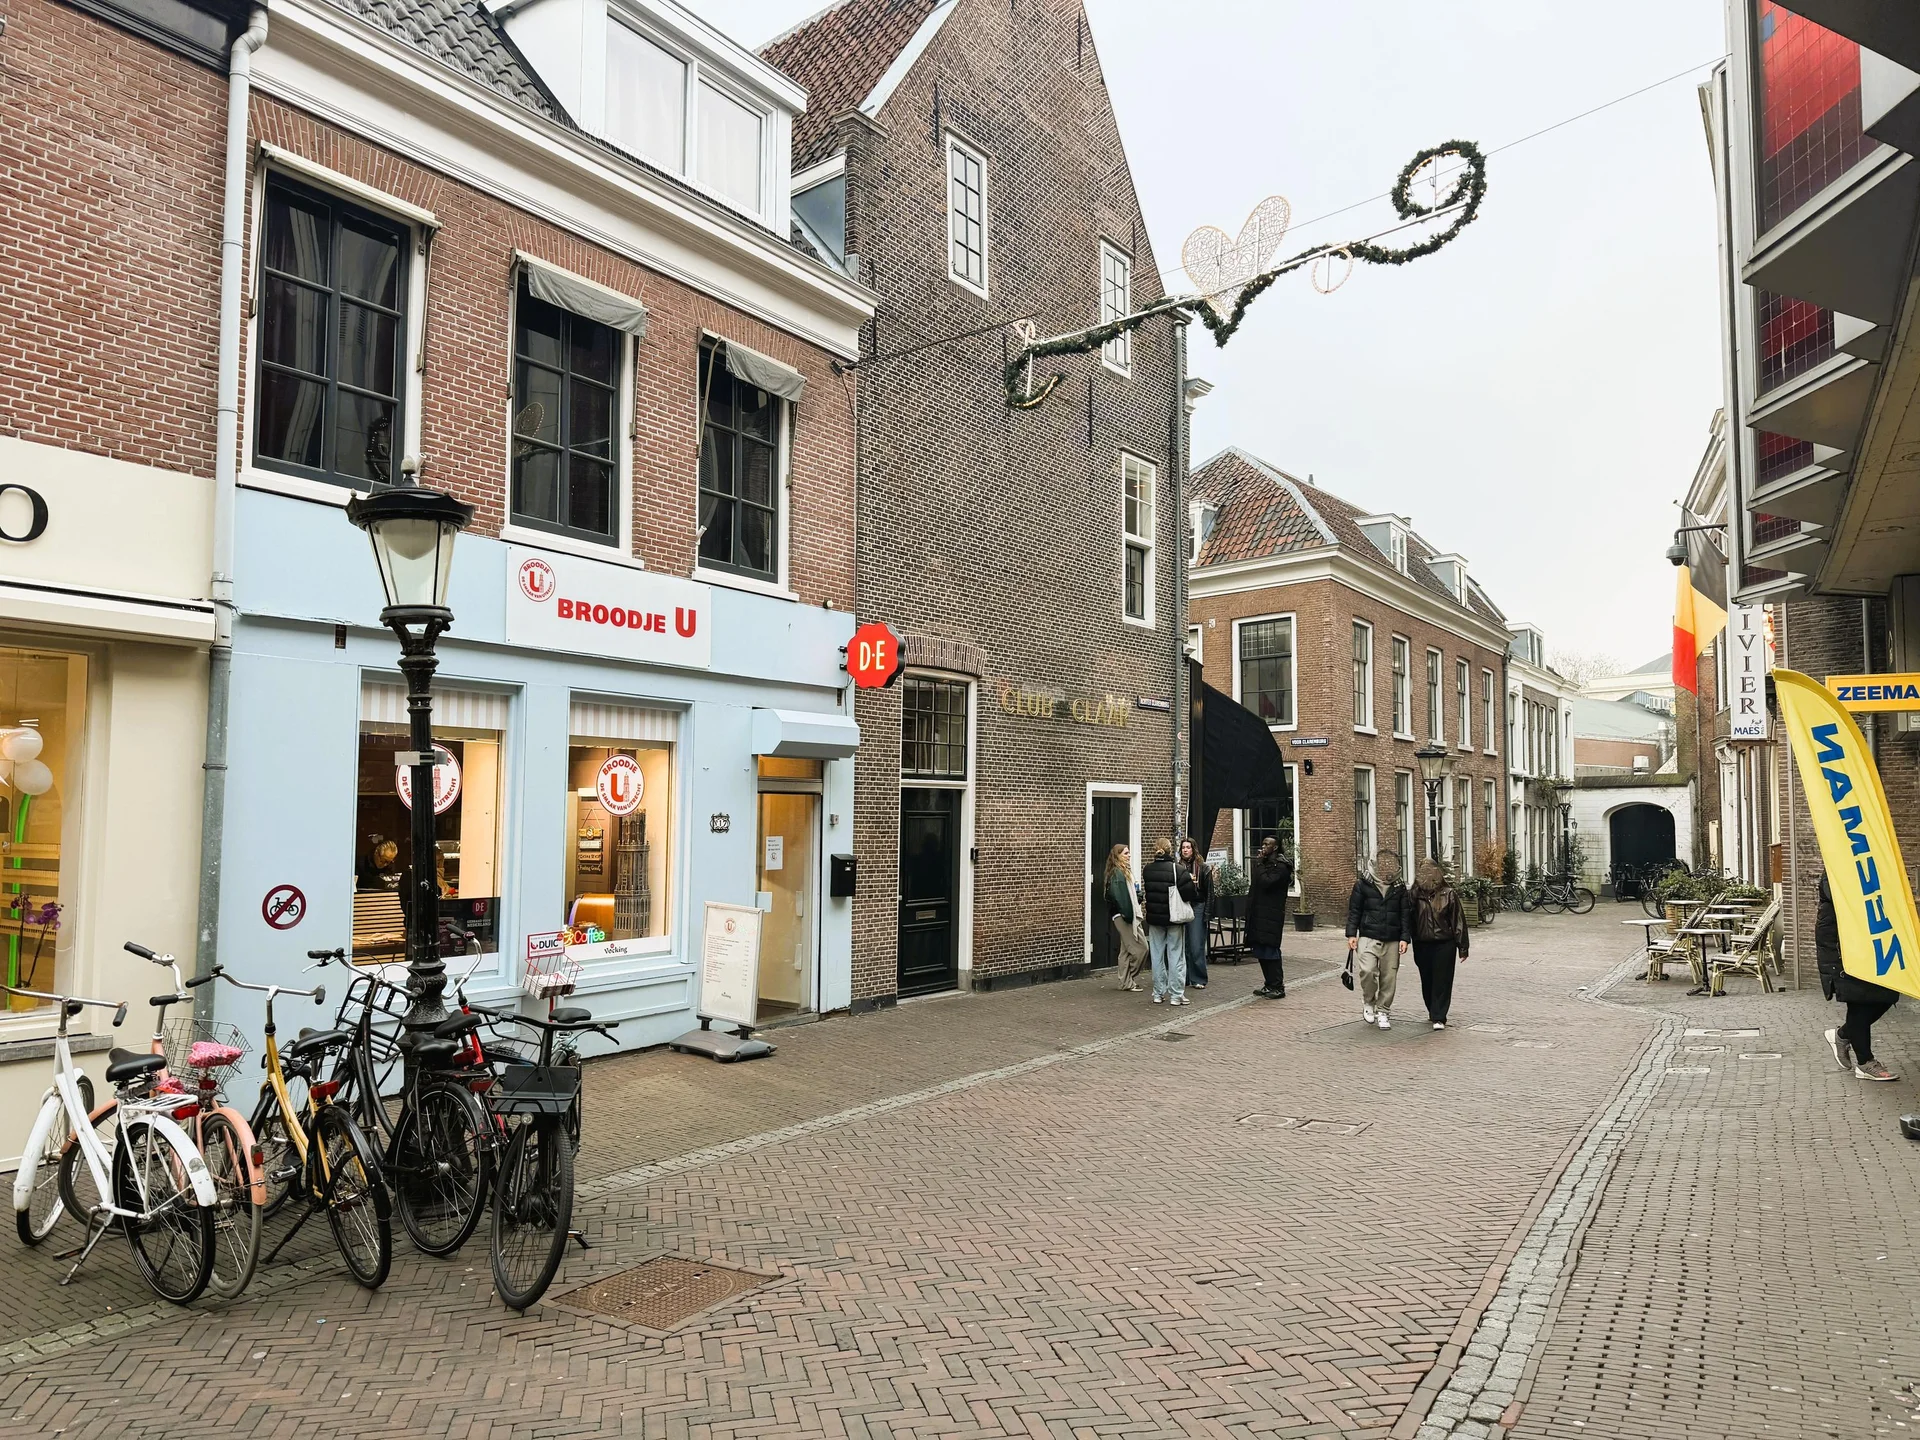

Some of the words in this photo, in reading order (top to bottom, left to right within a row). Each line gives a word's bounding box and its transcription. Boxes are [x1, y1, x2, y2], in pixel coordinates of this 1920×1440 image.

[558, 598, 666, 633] BROODJE
[675, 607, 696, 638] U
[1002, 688, 1052, 718] CLUB
[1734, 727, 1760, 735] MAES
[602, 759, 638, 775] BROODJE
[539, 938, 559, 949] DUIC
